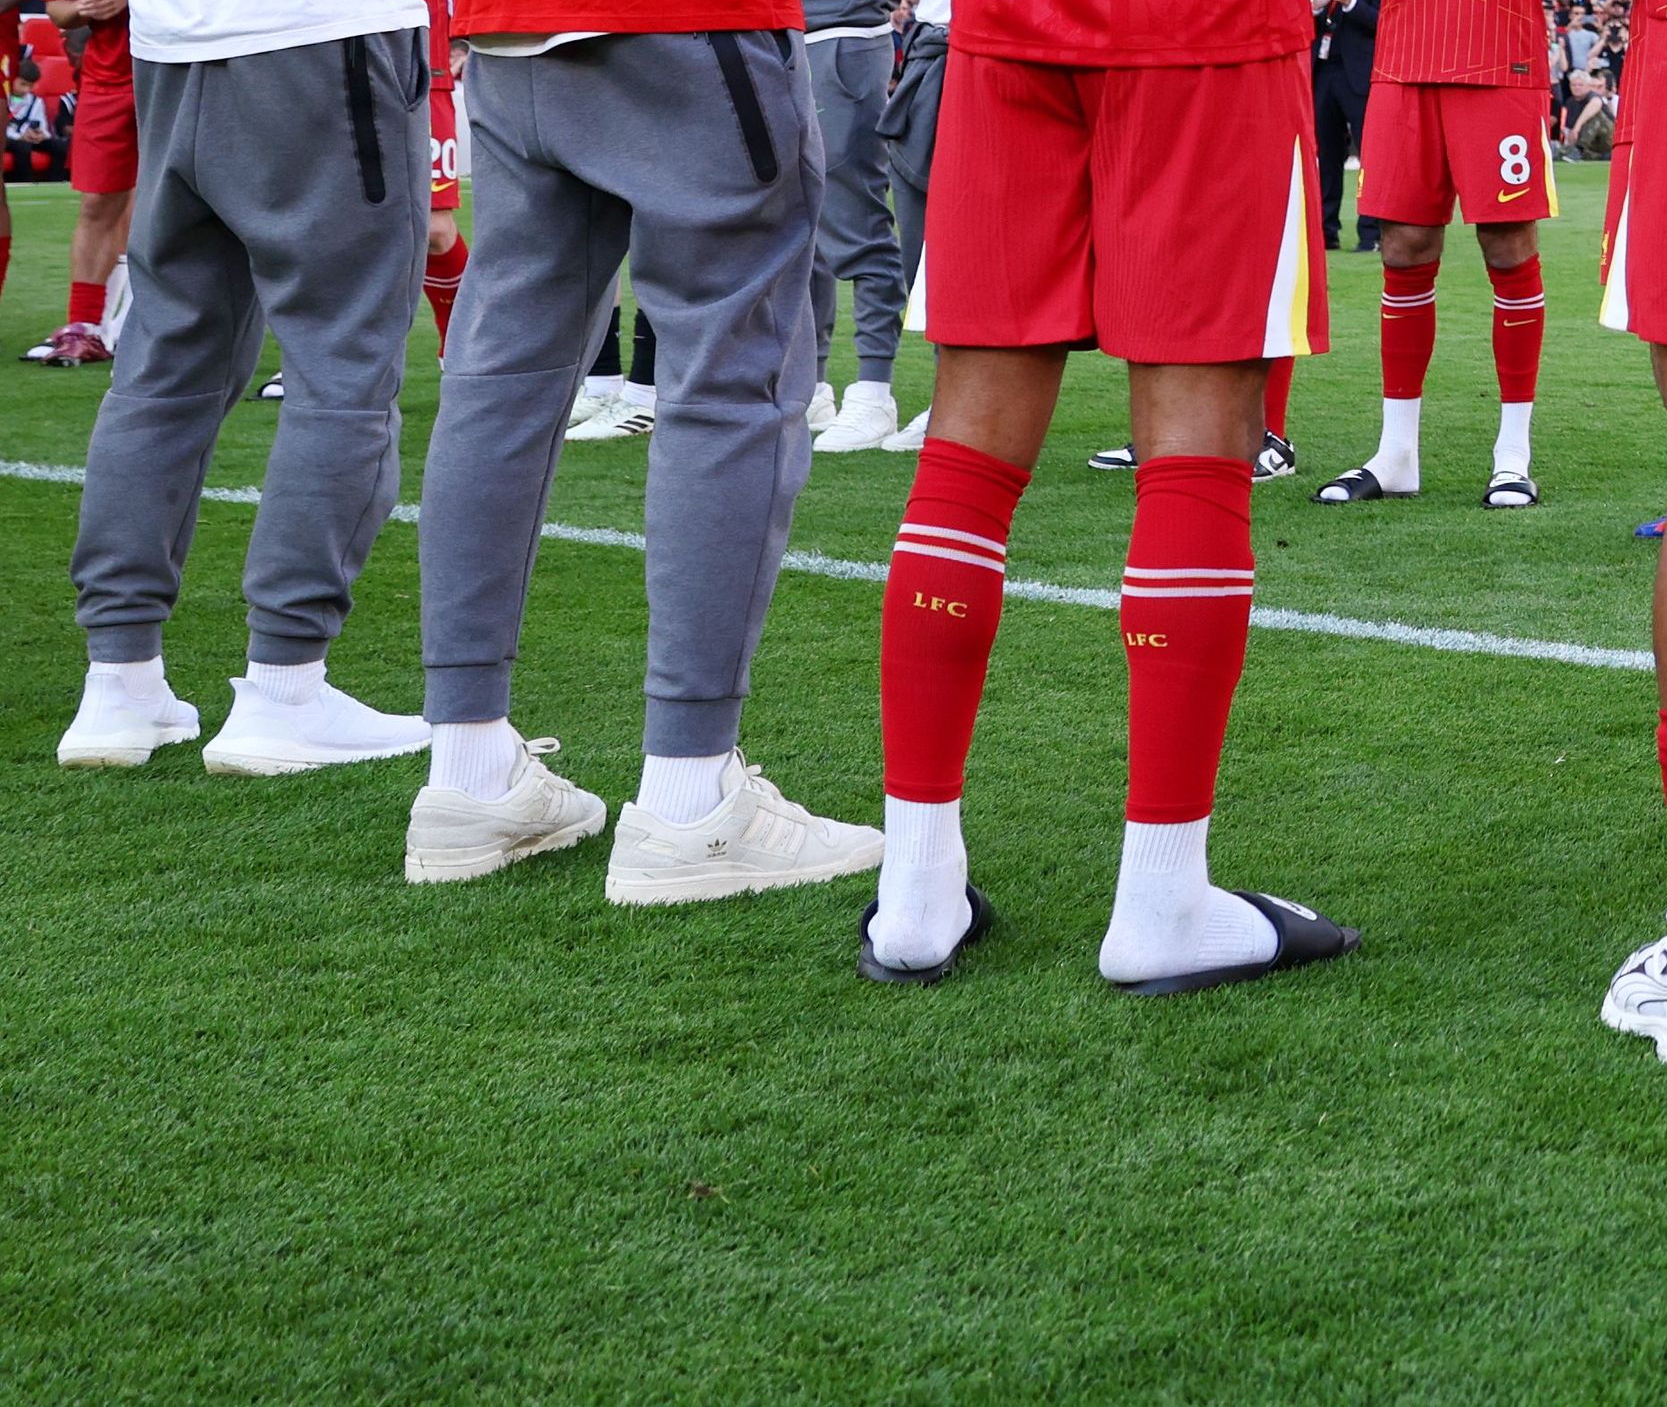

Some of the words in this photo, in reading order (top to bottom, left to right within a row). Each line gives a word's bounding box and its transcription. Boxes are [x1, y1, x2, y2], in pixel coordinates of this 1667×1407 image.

[430, 138, 458, 180] 20
[1499, 135, 1531, 185] 8
[912, 591, 968, 619] LFC
[1126, 632, 1168, 648] LFC
